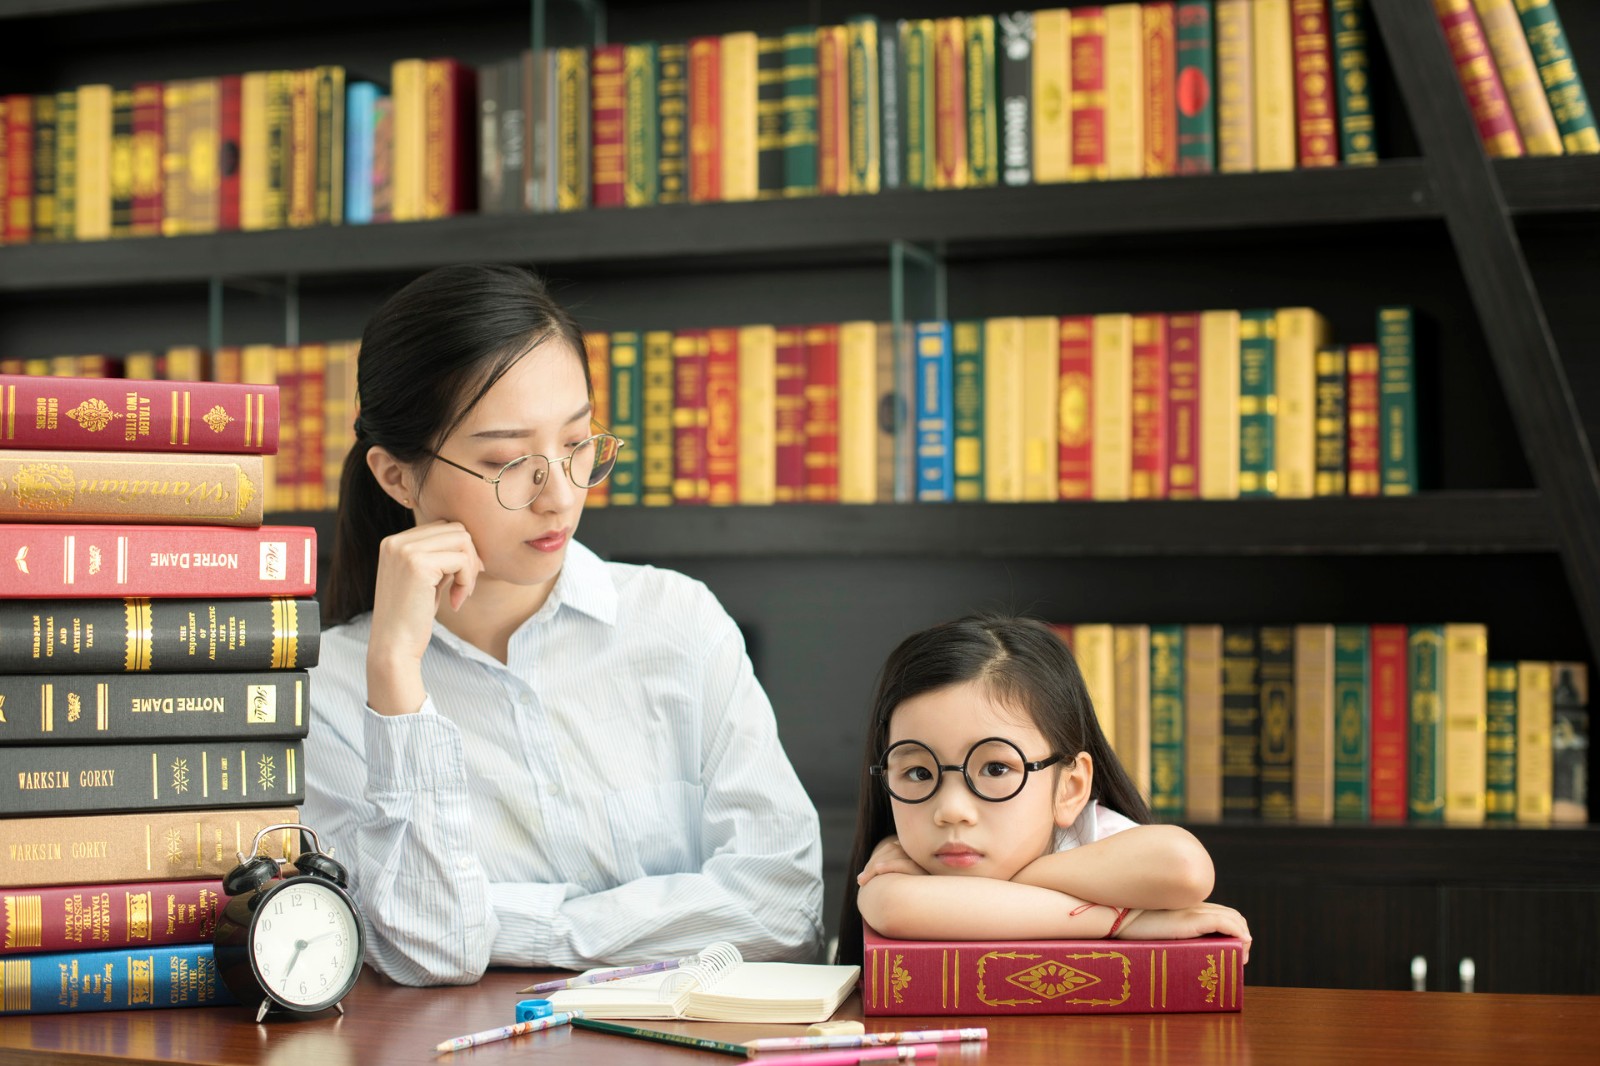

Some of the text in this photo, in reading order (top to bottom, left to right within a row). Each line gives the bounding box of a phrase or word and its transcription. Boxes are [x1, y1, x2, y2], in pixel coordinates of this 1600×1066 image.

[48, 398, 57, 429] CHARLES
[126, 392, 137, 441] TWO CITIES
[77, 477, 231, 505] Wandian
[150, 553, 238, 569] NOTRE DAME
[189, 612, 197, 655] ENJOYMENT
[200, 629, 206, 638] OF
[132, 697, 224, 714] NOTRE DAME
[19, 769, 115, 790] WARKSIM GORKY
[72, 842, 107, 858] GORKY
[274, 902, 283, 915] 11
[291, 894, 302, 907] 12
[313, 898, 318, 910] 1
[65, 898, 73, 939] OF MAN
[74, 894, 82, 942] DESCENT
[92, 896, 100, 939] DARWIN
[101, 893, 109, 941] CHARLES
[262, 919, 271, 931] 10
[328, 912, 335, 924] 2
[335, 934, 342, 946] 3
[256, 943, 262, 954] 9
[263, 964, 270, 976] 8
[331, 957, 338, 968] 4
[180, 959, 188, 1001] DARWIN
[189, 969, 197, 991] THE
[198, 955, 206, 1002] DESCENT
[207, 960, 215, 999] OF MAN
[280, 979, 287, 991] 7
[320, 974, 326, 986] 5
[300, 982, 307, 994] 6
